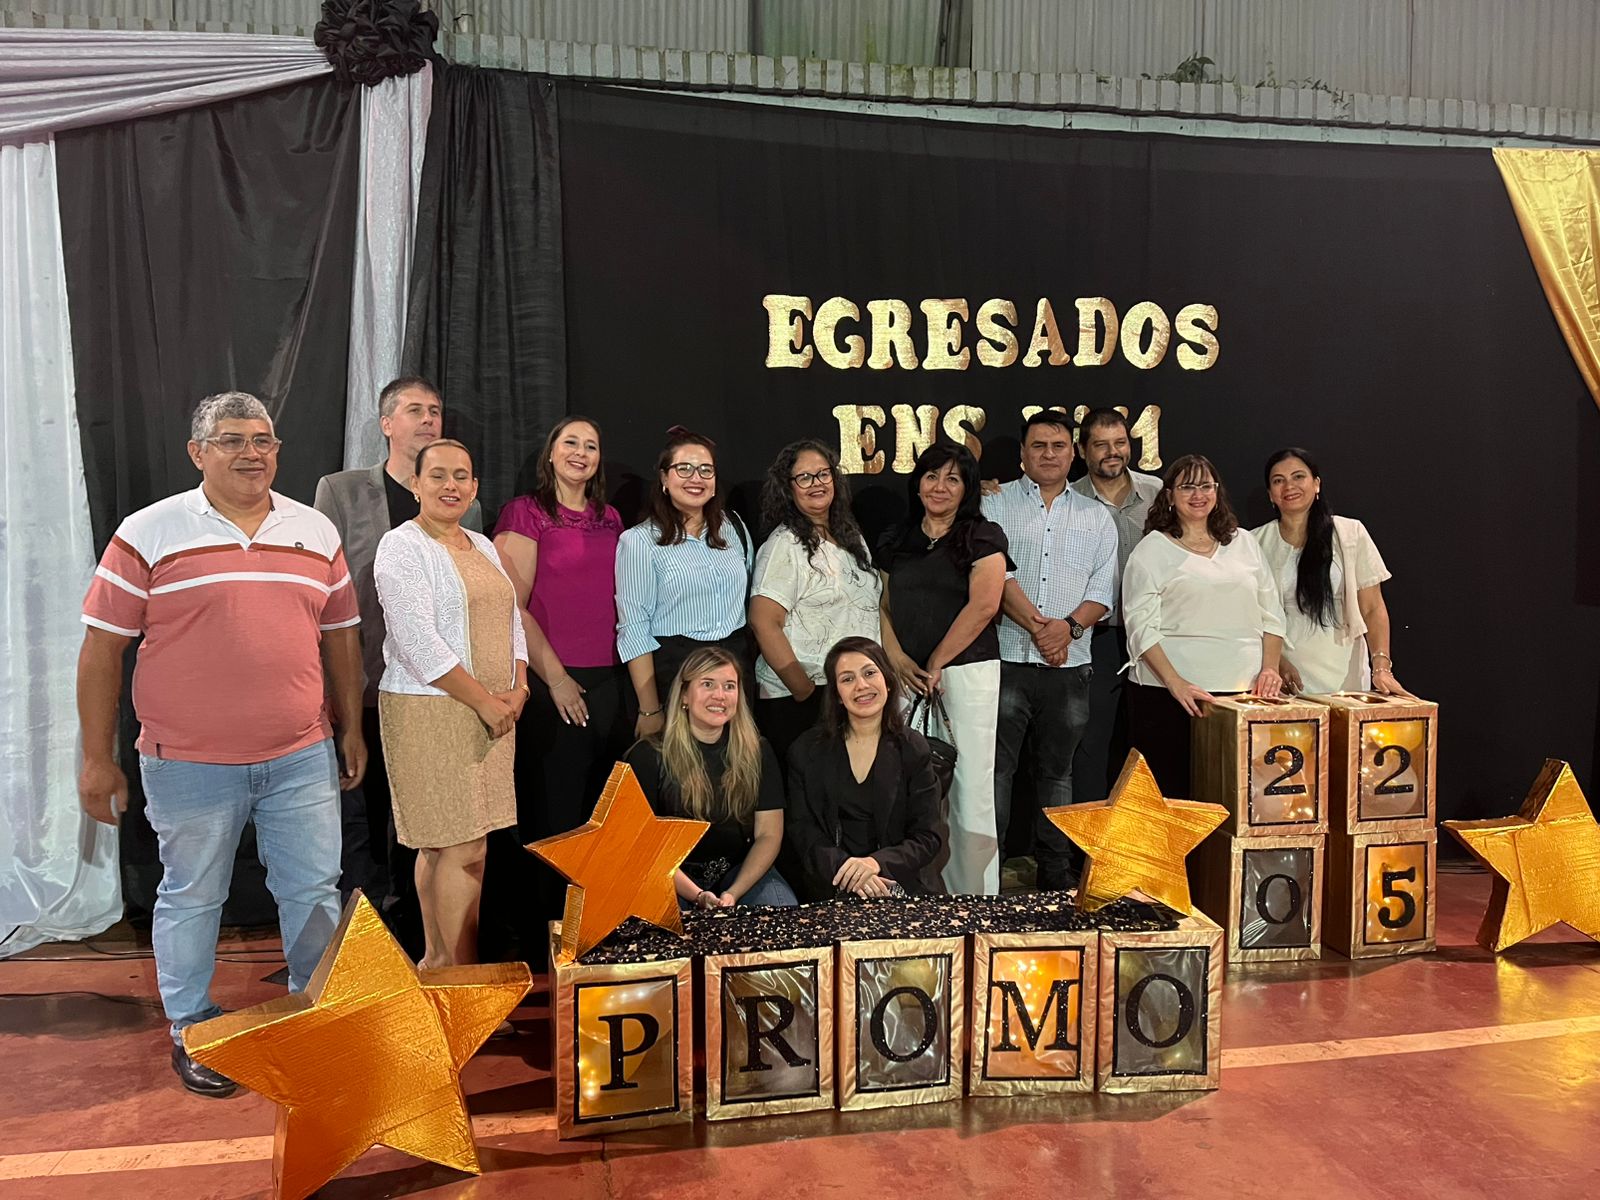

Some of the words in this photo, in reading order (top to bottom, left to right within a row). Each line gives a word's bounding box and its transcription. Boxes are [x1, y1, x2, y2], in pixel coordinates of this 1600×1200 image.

[762, 294, 1221, 370] EGRESADOS
[832, 404, 986, 474] ENS
[598, 972, 1191, 1091] PROMO
